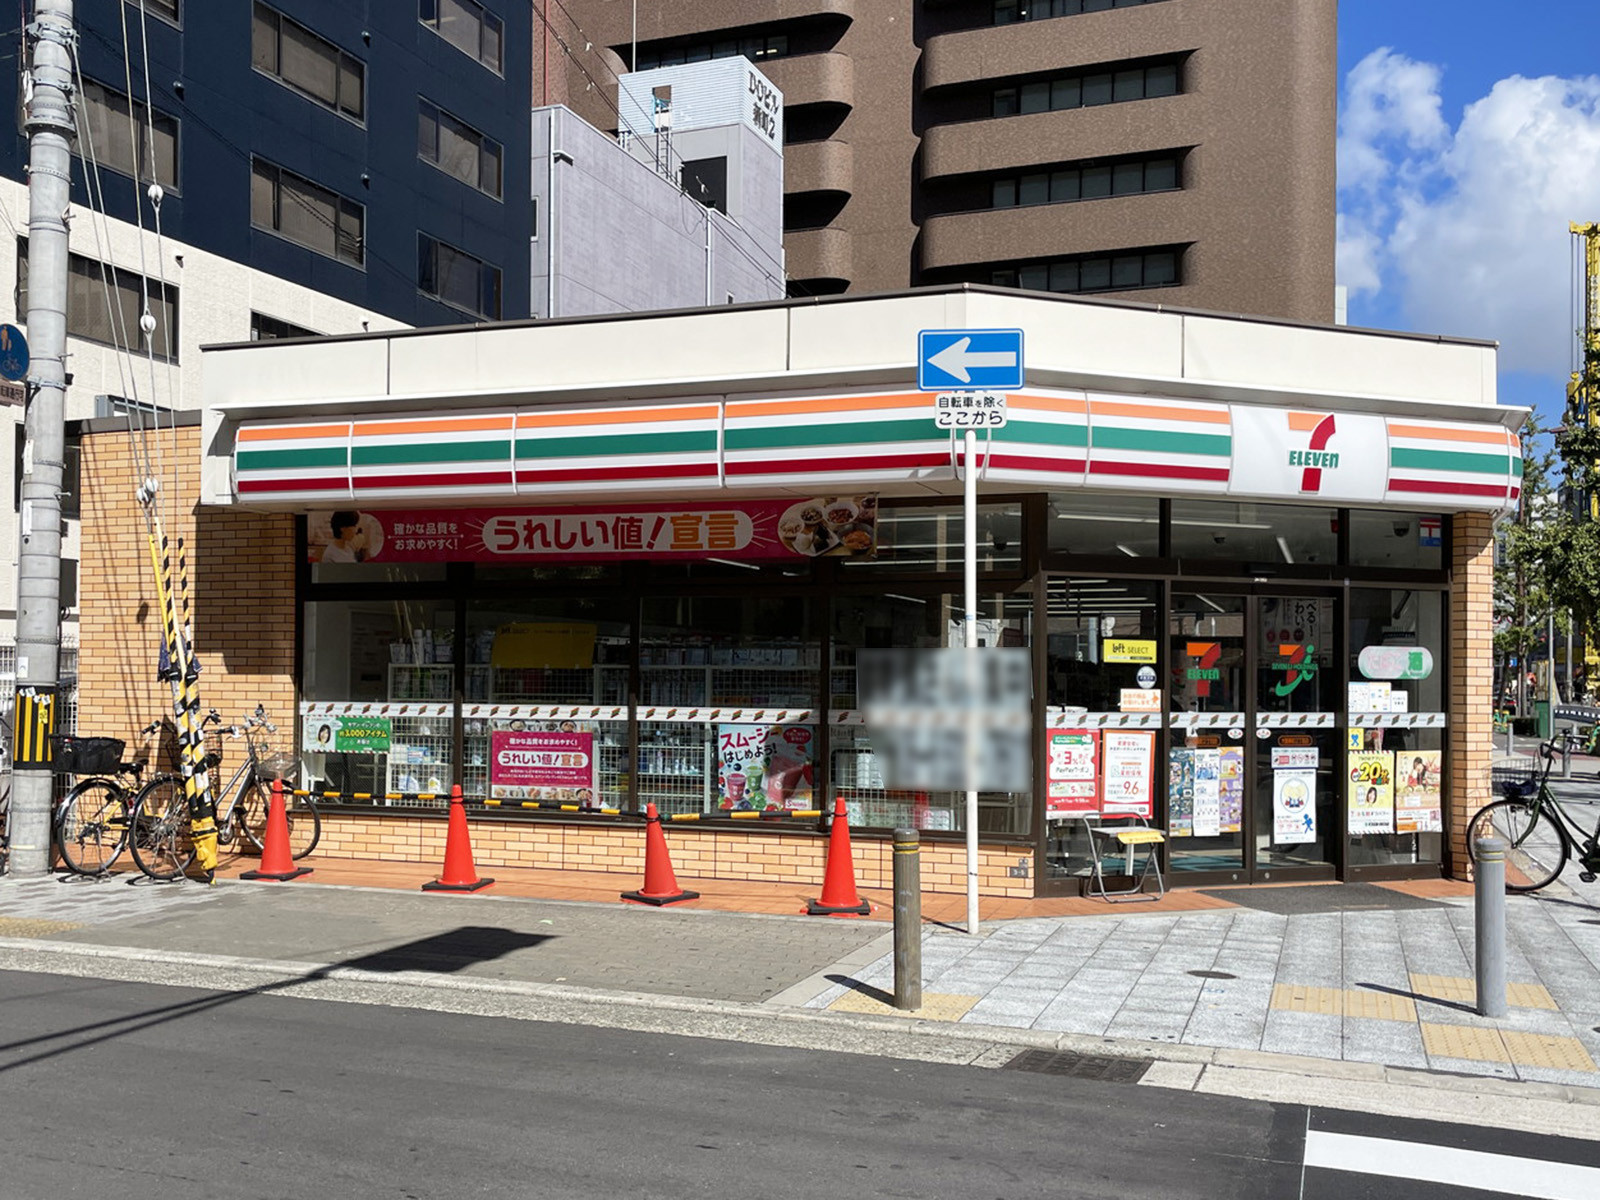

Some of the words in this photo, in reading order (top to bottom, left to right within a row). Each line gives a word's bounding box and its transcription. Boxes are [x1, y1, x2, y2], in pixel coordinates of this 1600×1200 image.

[938, 396, 1004, 409] 自転車を除く
[939, 410, 1003, 426] ここから
[393, 522, 458, 535] 確かな品質を
[494, 513, 739, 551] うれしい値!宣言
[1127, 646, 1149, 654] SELECT
[720, 725, 779, 751] スムージー
[723, 743, 778, 764] はじめよう!
